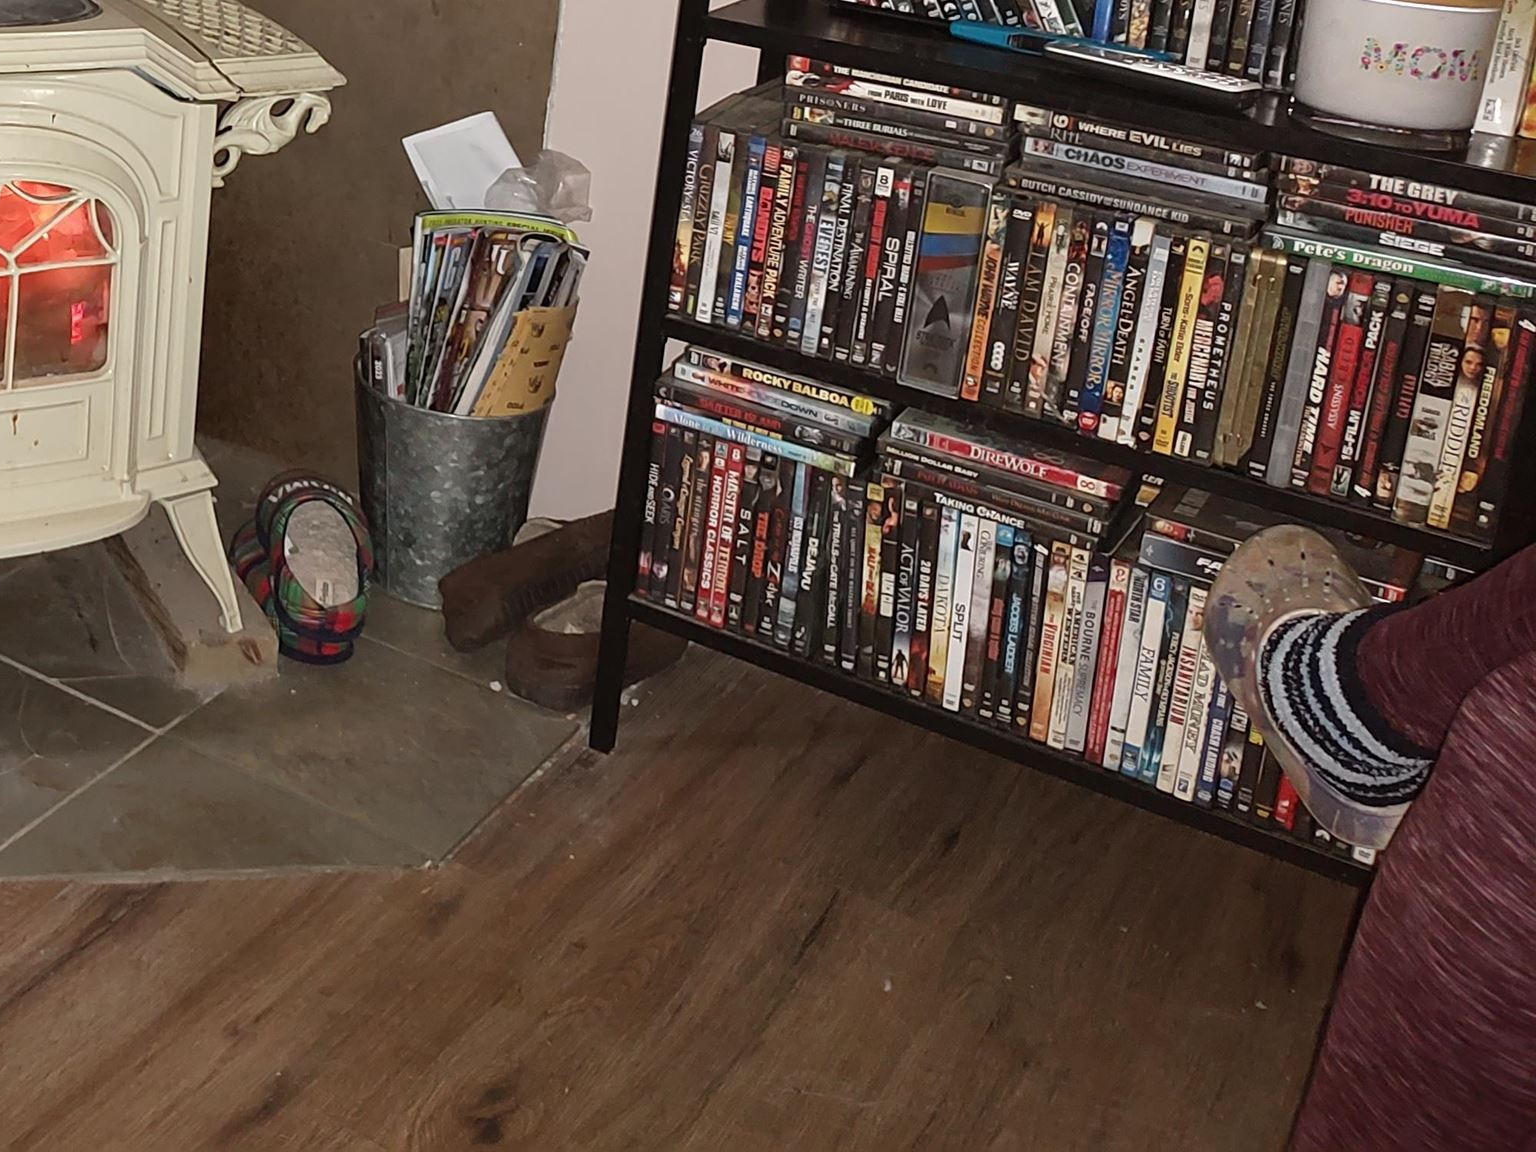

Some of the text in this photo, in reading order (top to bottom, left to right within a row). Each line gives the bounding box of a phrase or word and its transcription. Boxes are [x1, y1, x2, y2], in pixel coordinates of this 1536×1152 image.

[832, 66, 850, 75] THE
[1360, 37, 1479, 81] MOM
[798, 93, 867, 113] PRISONERS
[883, 89, 947, 110] PARIS LOVE
[1077, 121, 1202, 157] WHERE EVIL LIES
[682, 148, 700, 197] VICTORY
[1063, 147, 1207, 186] CHAOS EXPERIMENT
[1368, 174, 1457, 206] THE GREY
[687, 162, 714, 265] GRIZZLY PARK
[1021, 178, 1189, 223] BUTCH CASSIDY SUNDANCE KID
[1344, 206, 1413, 234] PUNISHER
[1346, 188, 1481, 228] 3:10 TO YUMA
[762, 164, 794, 298] FAMILY ADVENTURE PACK
[793, 203, 816, 299] THE WRITER
[812, 218, 834, 274] EVEREST
[825, 182, 853, 292] FINAL DESTINATION
[1378, 232, 1445, 256] SIEGE
[841, 242, 863, 300] AWAKENING
[876, 236, 900, 303] SPIRAL
[1025, 263, 1042, 291] AM
[1292, 241, 1414, 276] Pete's Dragon
[1000, 260, 1019, 309] WAYNE
[1013, 299, 1036, 361] DAVID
[1050, 261, 1080, 369] CONTAINMENT
[1077, 282, 1095, 342] FACE/OFF
[1087, 268, 1122, 385] MIRROR MIRROR
[1153, 306, 1172, 362] TURN FAITH
[969, 318, 986, 370] COLLECTION
[1111, 317, 1133, 365] DEATH
[1186, 318, 1214, 388] MERCENARY
[1202, 301, 1231, 410] PROMETHEUS
[1422, 341, 1442, 386] TRILOGY
[740, 367, 850, 406] ROCKY BALBOA
[1340, 310, 1382, 461] 15-FILM PACK
[1436, 346, 1458, 389] SABATA
[779, 400, 818, 417] DOWN
[1161, 379, 1179, 418] SHOOTIST
[1301, 346, 1330, 454] HARD TIME
[1467, 365, 1496, 459] FREEDOMLAND
[724, 426, 785, 453] Wilderness
[885, 446, 979, 478] MILLION DOLLAR BABY
[968, 446, 1048, 478] DIREWOLF
[646, 463, 661, 486] HIDE
[642, 499, 657, 524] SEEK
[698, 474, 724, 589] HORROR CLASSICS
[713, 470, 741, 593] MASTER OF TERROR
[931, 492, 976, 513] TAKING
[975, 505, 1026, 528] CHANCE
[733, 508, 752, 565] SALT
[750, 511, 768, 578] THE DROP
[829, 522, 842, 556] TRIALS
[827, 564, 838, 588] CATE
[893, 543, 915, 633] ACT OF VALOR
[914, 559, 931, 631] 28 DAYS LATER
[1152, 577, 1165, 591] 6
[930, 573, 951, 634] DAKOTA
[950, 602, 965, 642] SPLIT
[1127, 602, 1141, 623] STAR
[1039, 622, 1057, 674] VIRGINIAN
[1060, 607, 1073, 663] WESTERN
[1068, 608, 1081, 665] AMERICAN
[1071, 611, 1095, 716] BOURNE SUPREMACY
[1133, 646, 1155, 702] FAMILY
[1169, 646, 1196, 726] INSANITARIUM
[1208, 718, 1222, 746] CRASH
